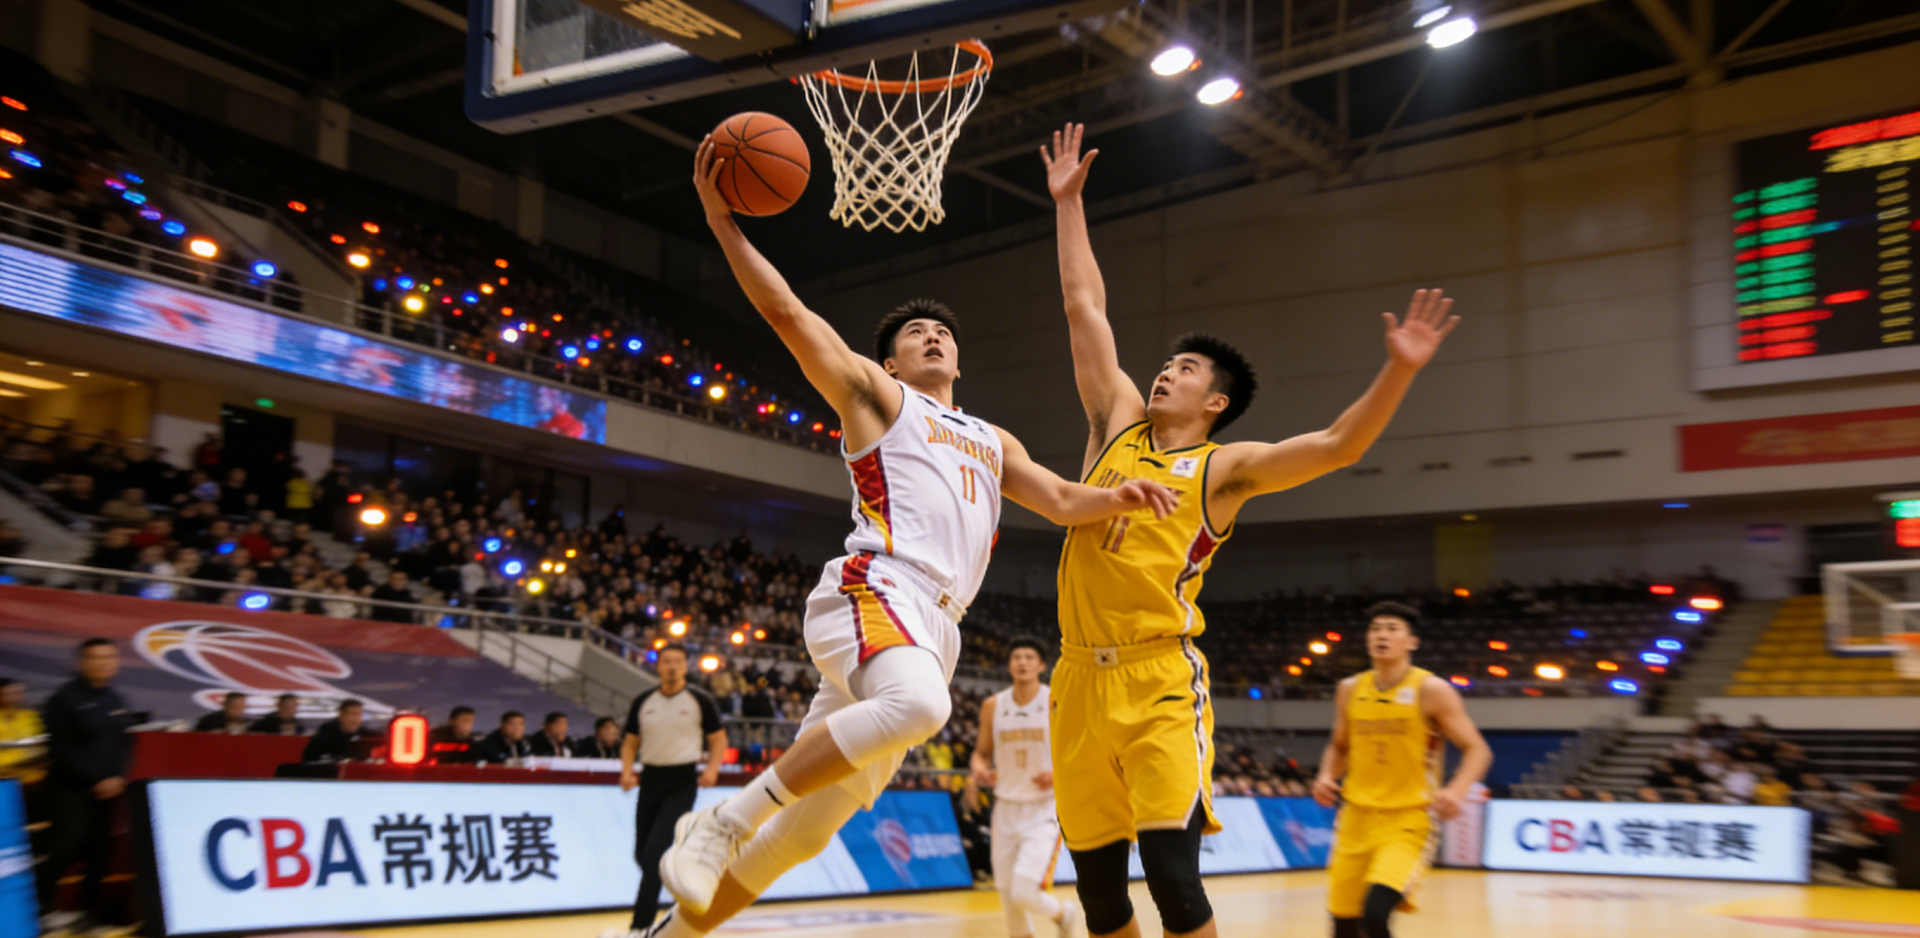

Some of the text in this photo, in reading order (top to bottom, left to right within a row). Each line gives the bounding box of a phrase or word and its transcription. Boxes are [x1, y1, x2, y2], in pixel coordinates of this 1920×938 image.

[960, 464, 976, 504] 11
[391, 715, 427, 763] 0
[205, 812, 560, 892] CBA 常规赛
[1515, 818, 1609, 855] CBA
[1616, 819, 1758, 863] 常规赛
